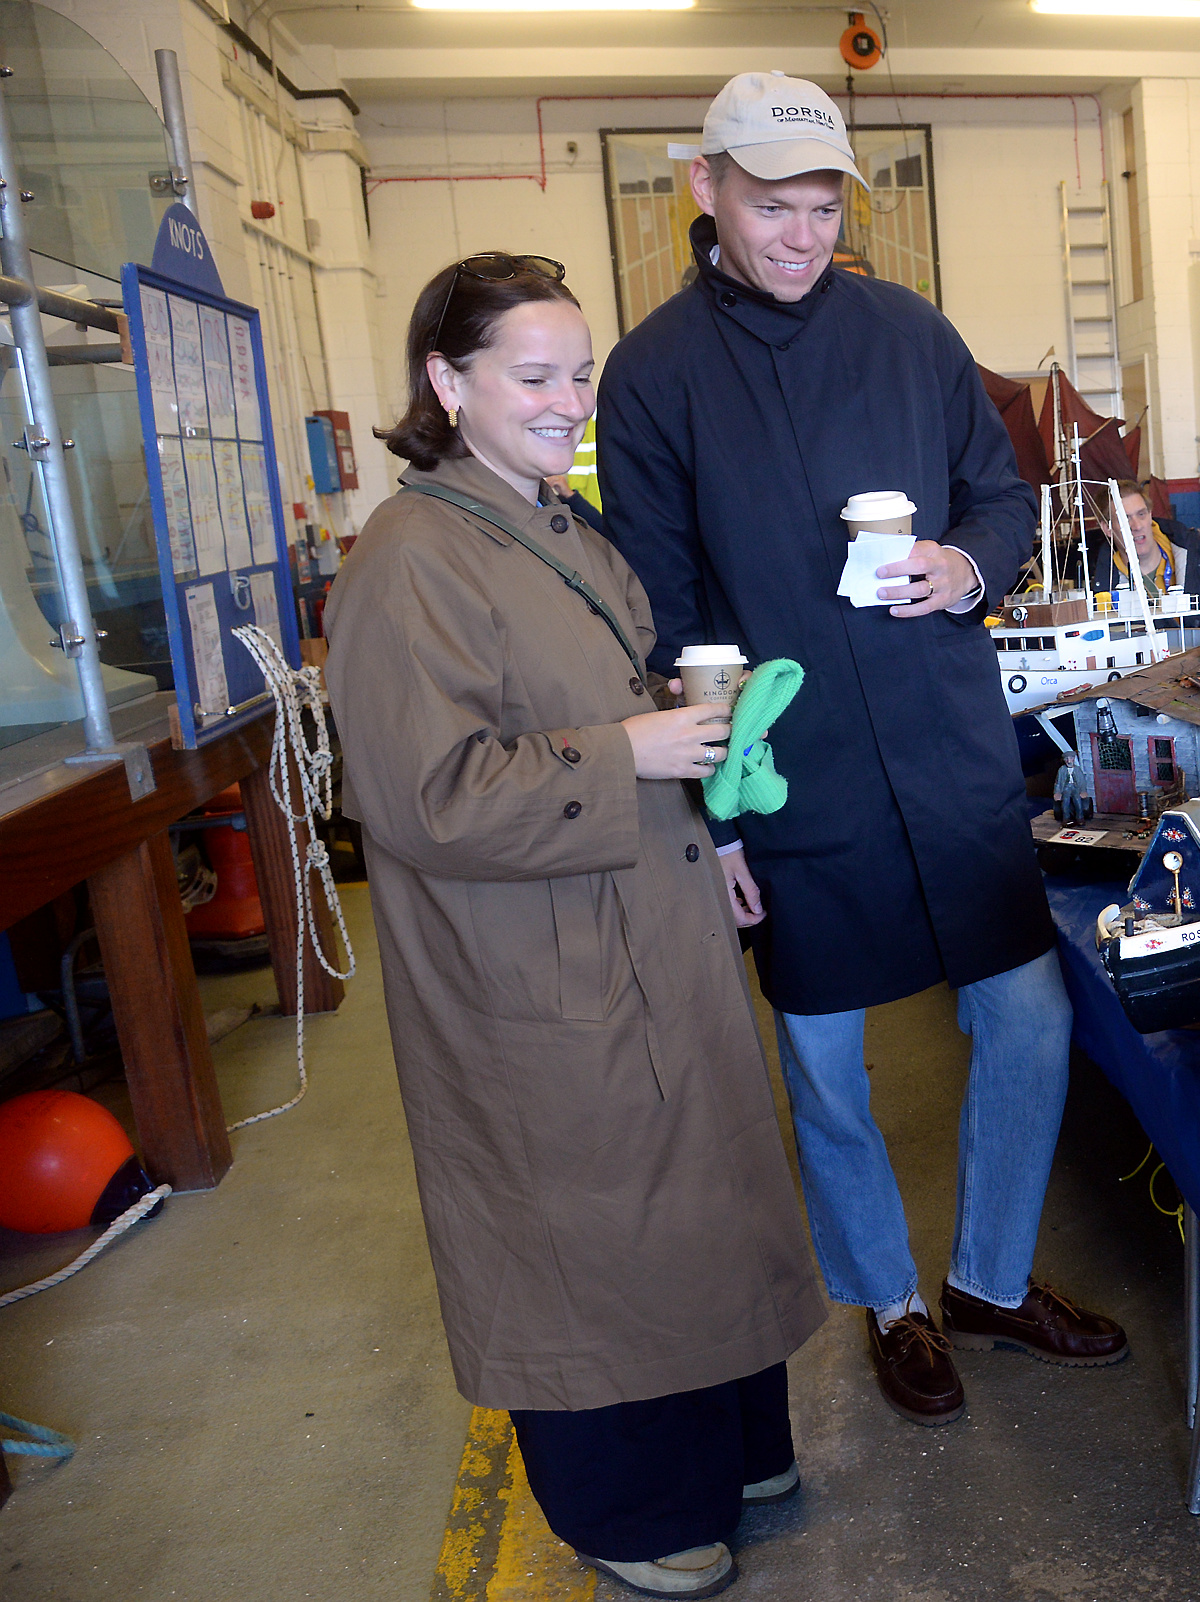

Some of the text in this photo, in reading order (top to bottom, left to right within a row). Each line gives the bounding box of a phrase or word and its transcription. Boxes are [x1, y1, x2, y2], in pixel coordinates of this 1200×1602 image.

[771, 107, 835, 126] DORSIA
[169, 217, 204, 260] KNOTS
[1040, 676, 1058, 686] Orca
